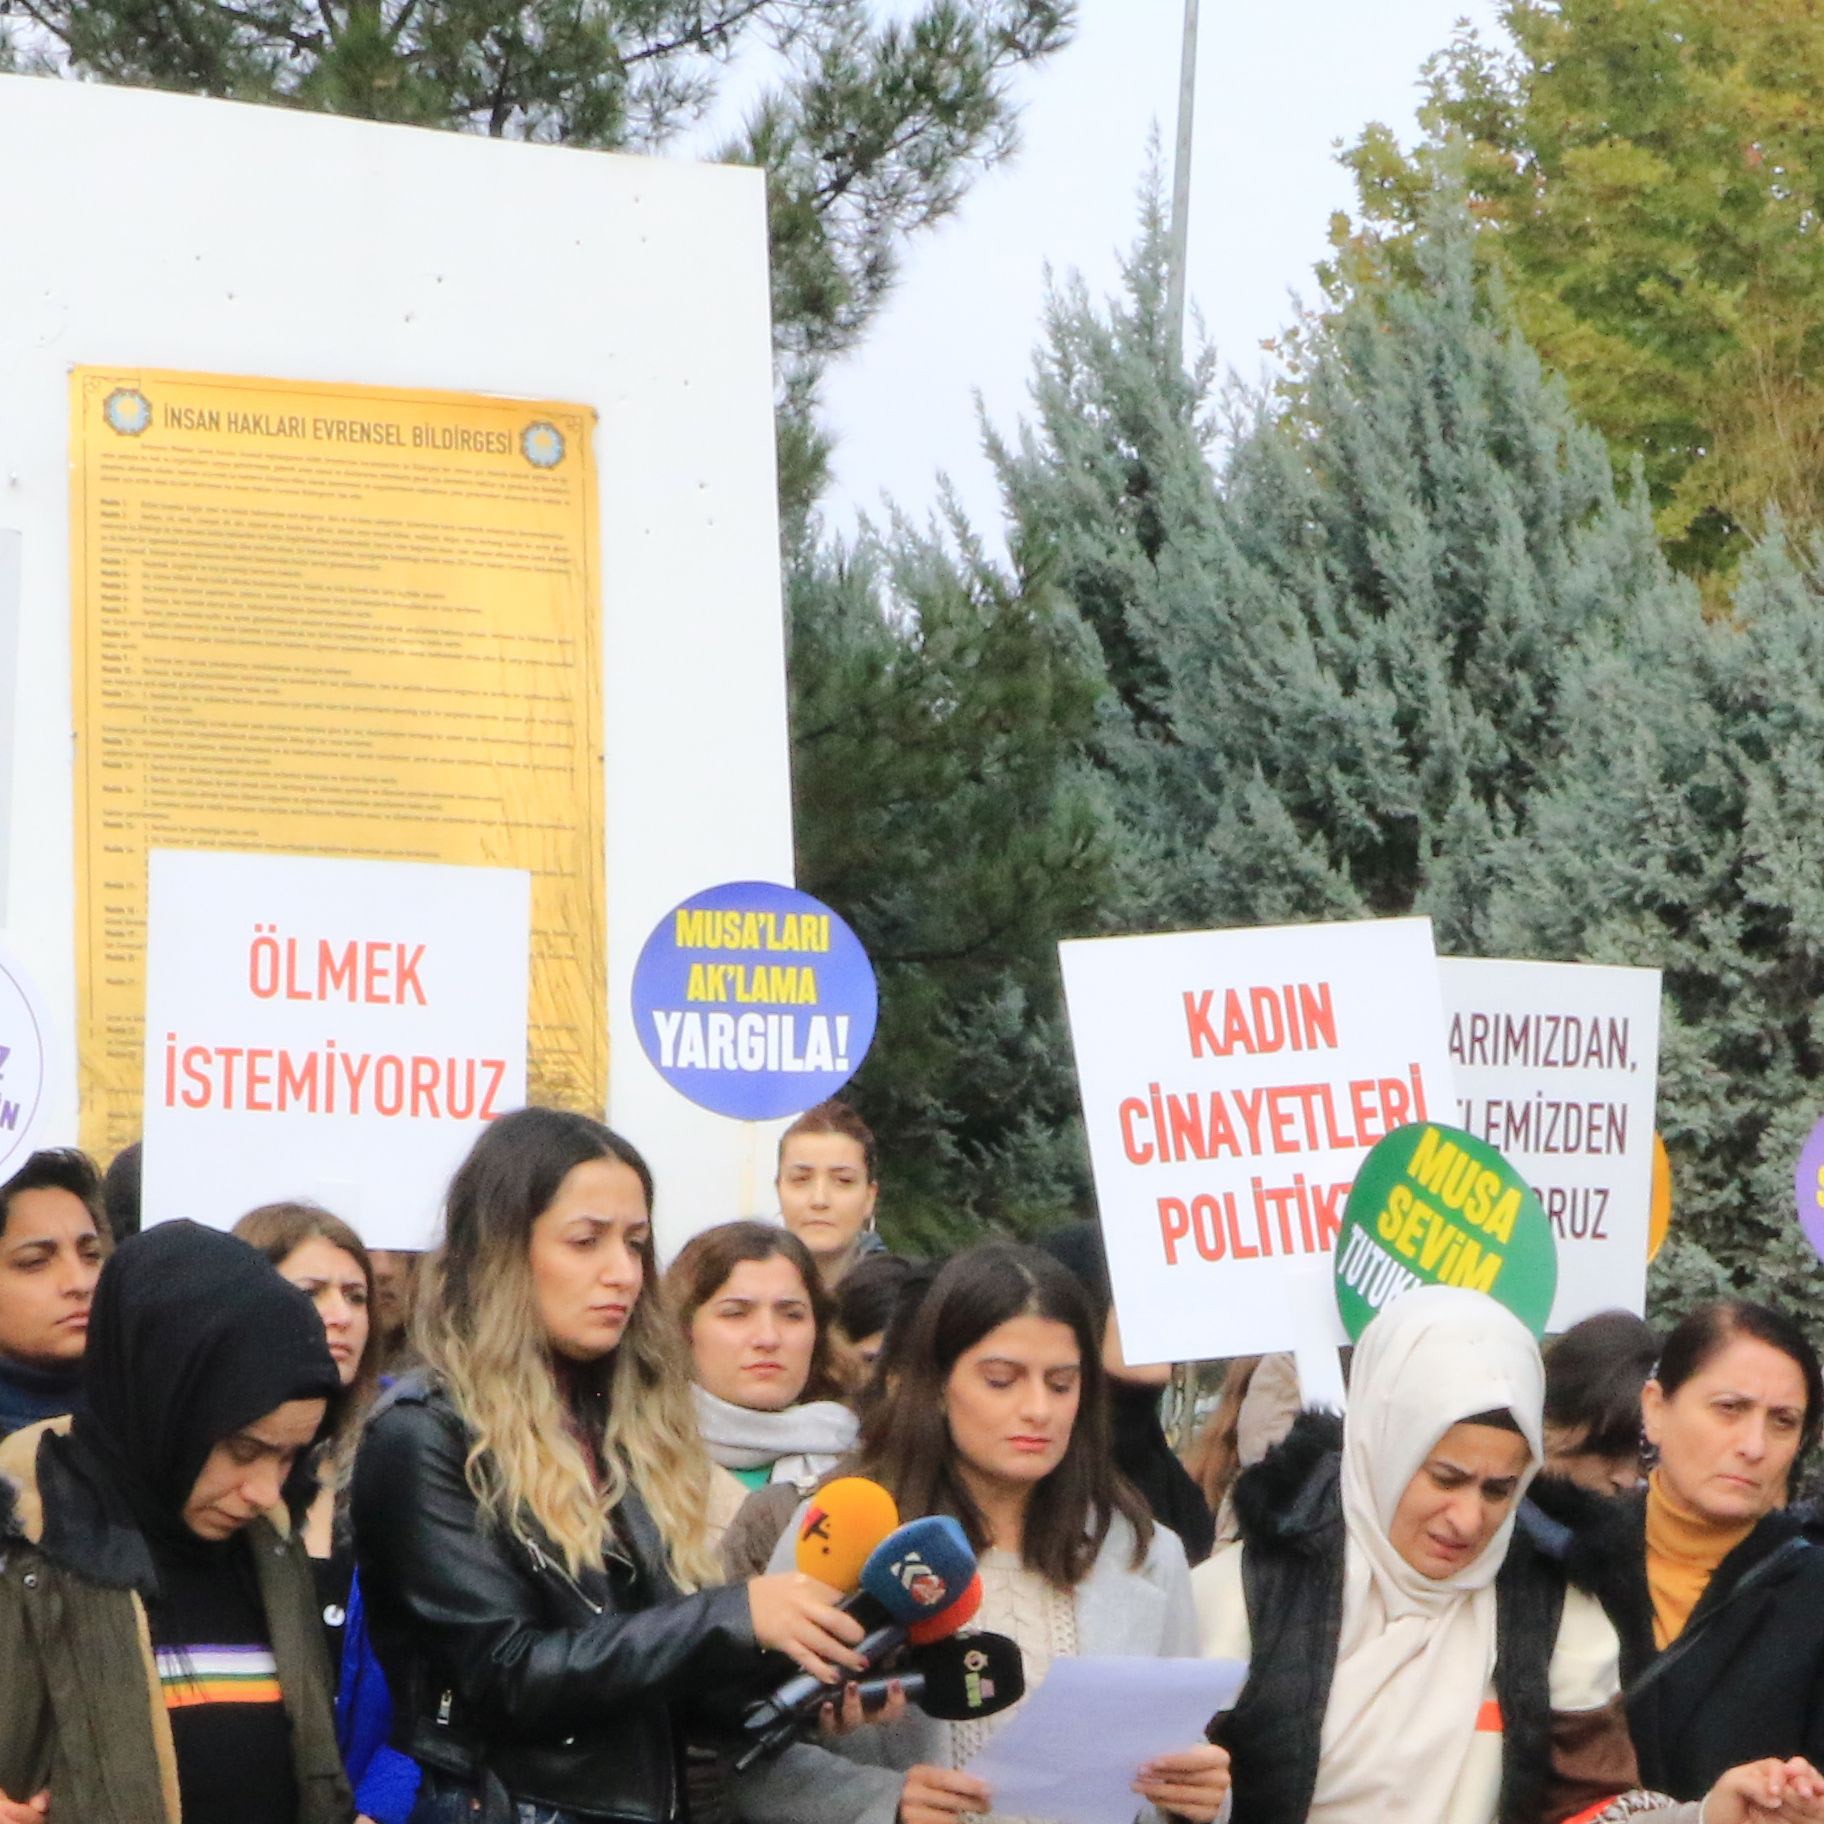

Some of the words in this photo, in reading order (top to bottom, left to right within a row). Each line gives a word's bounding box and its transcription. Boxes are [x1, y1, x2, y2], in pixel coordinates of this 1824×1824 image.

[163, 403, 221, 432] İNSAN
[227, 412, 307, 438] HAKLARI
[312, 420, 405, 447] EVRENSEL
[411, 422, 513, 455] BİLDİRGESİ
[249, 923, 428, 1006] ÖLMEK
[675, 909, 830, 953] MUSA'LARI
[686, 963, 818, 1005] AK'LAMA
[1182, 982, 1339, 1058] KADIN
[165, 1032, 507, 1121] İSTEMİYORUZ
[652, 1010, 849, 1072] YARGILA!
[1119, 1062, 1428, 1165] CİNAYETLERİ
[1156, 1173, 1354, 1266] POLİTİK
[1405, 1126, 1523, 1245] MUSA
